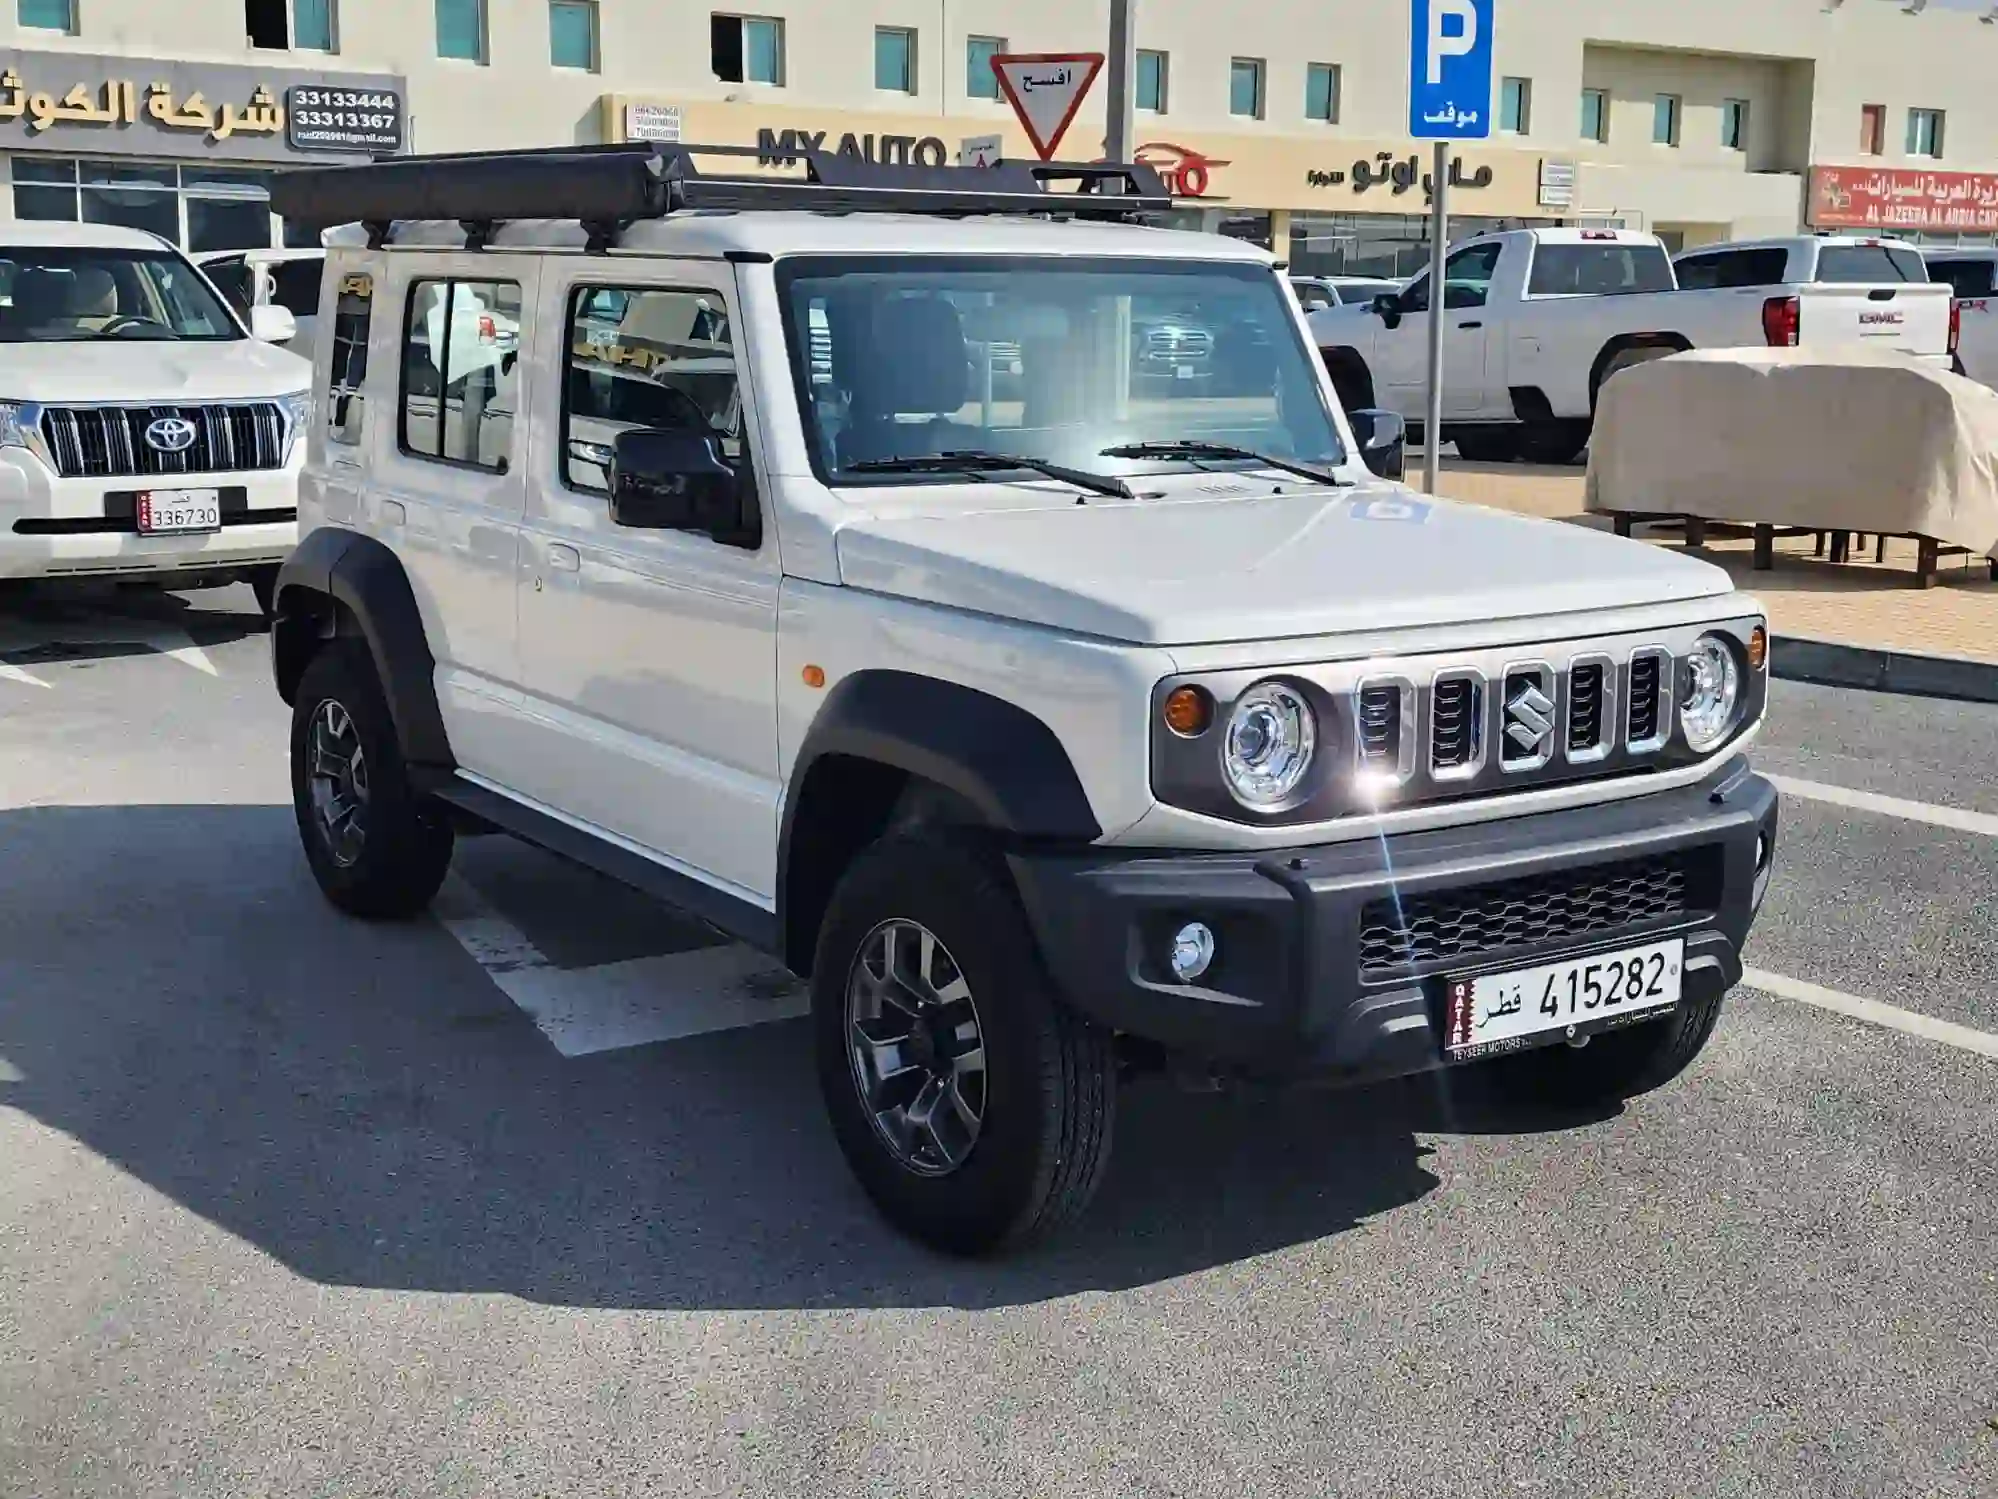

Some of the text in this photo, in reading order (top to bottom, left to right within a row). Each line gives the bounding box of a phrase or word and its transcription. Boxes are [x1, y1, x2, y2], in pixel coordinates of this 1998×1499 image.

[1427, 0, 1476, 84] P
[0, 66, 285, 141] شركة الكوث
[296, 90, 395, 109] 33133444
[1424, 101, 1478, 128] موقف
[296, 110, 395, 129] 33313367
[758, 128, 947, 168] MY AUTO
[1859, 311, 1905, 325] GMC
[154, 507, 217, 526] 336730
[1540, 952, 1666, 1019] 415282
[1452, 983, 1465, 1044] QATAR
[1475, 985, 1522, 1029] قطر
[1487, 1036, 1521, 1053] MOTORS
